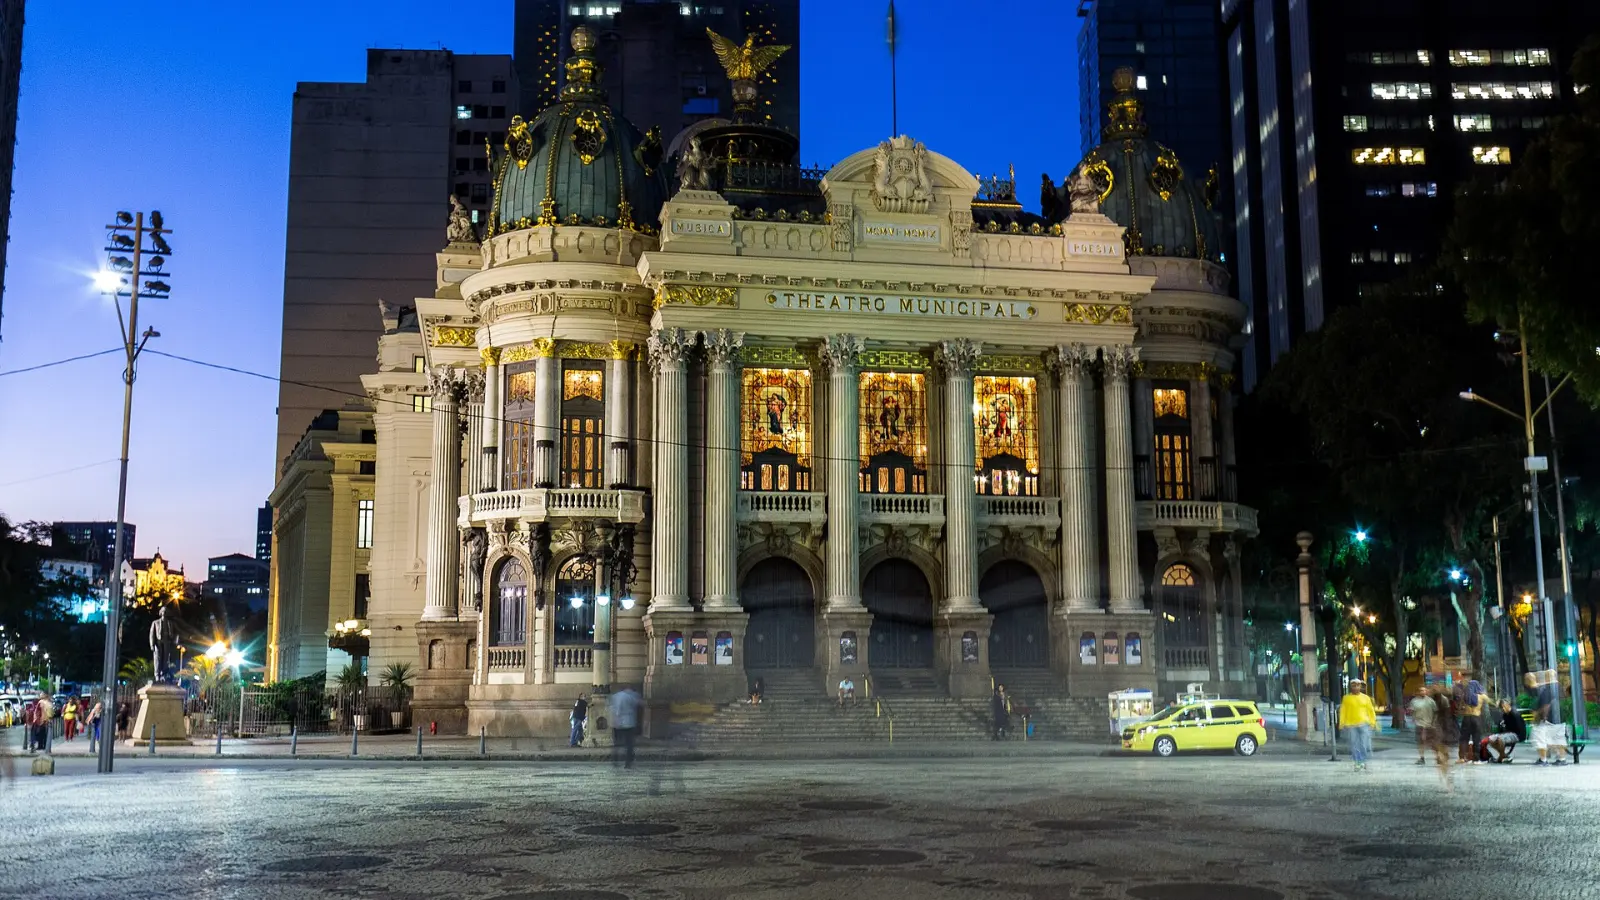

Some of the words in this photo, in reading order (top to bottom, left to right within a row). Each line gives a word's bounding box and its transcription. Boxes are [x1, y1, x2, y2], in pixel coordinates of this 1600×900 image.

[676, 222, 725, 234] MUSICA
[1073, 243, 1116, 255] POESIA
[783, 292, 886, 312] THEATRO
[899, 298, 1021, 318] MUNICIPAL
